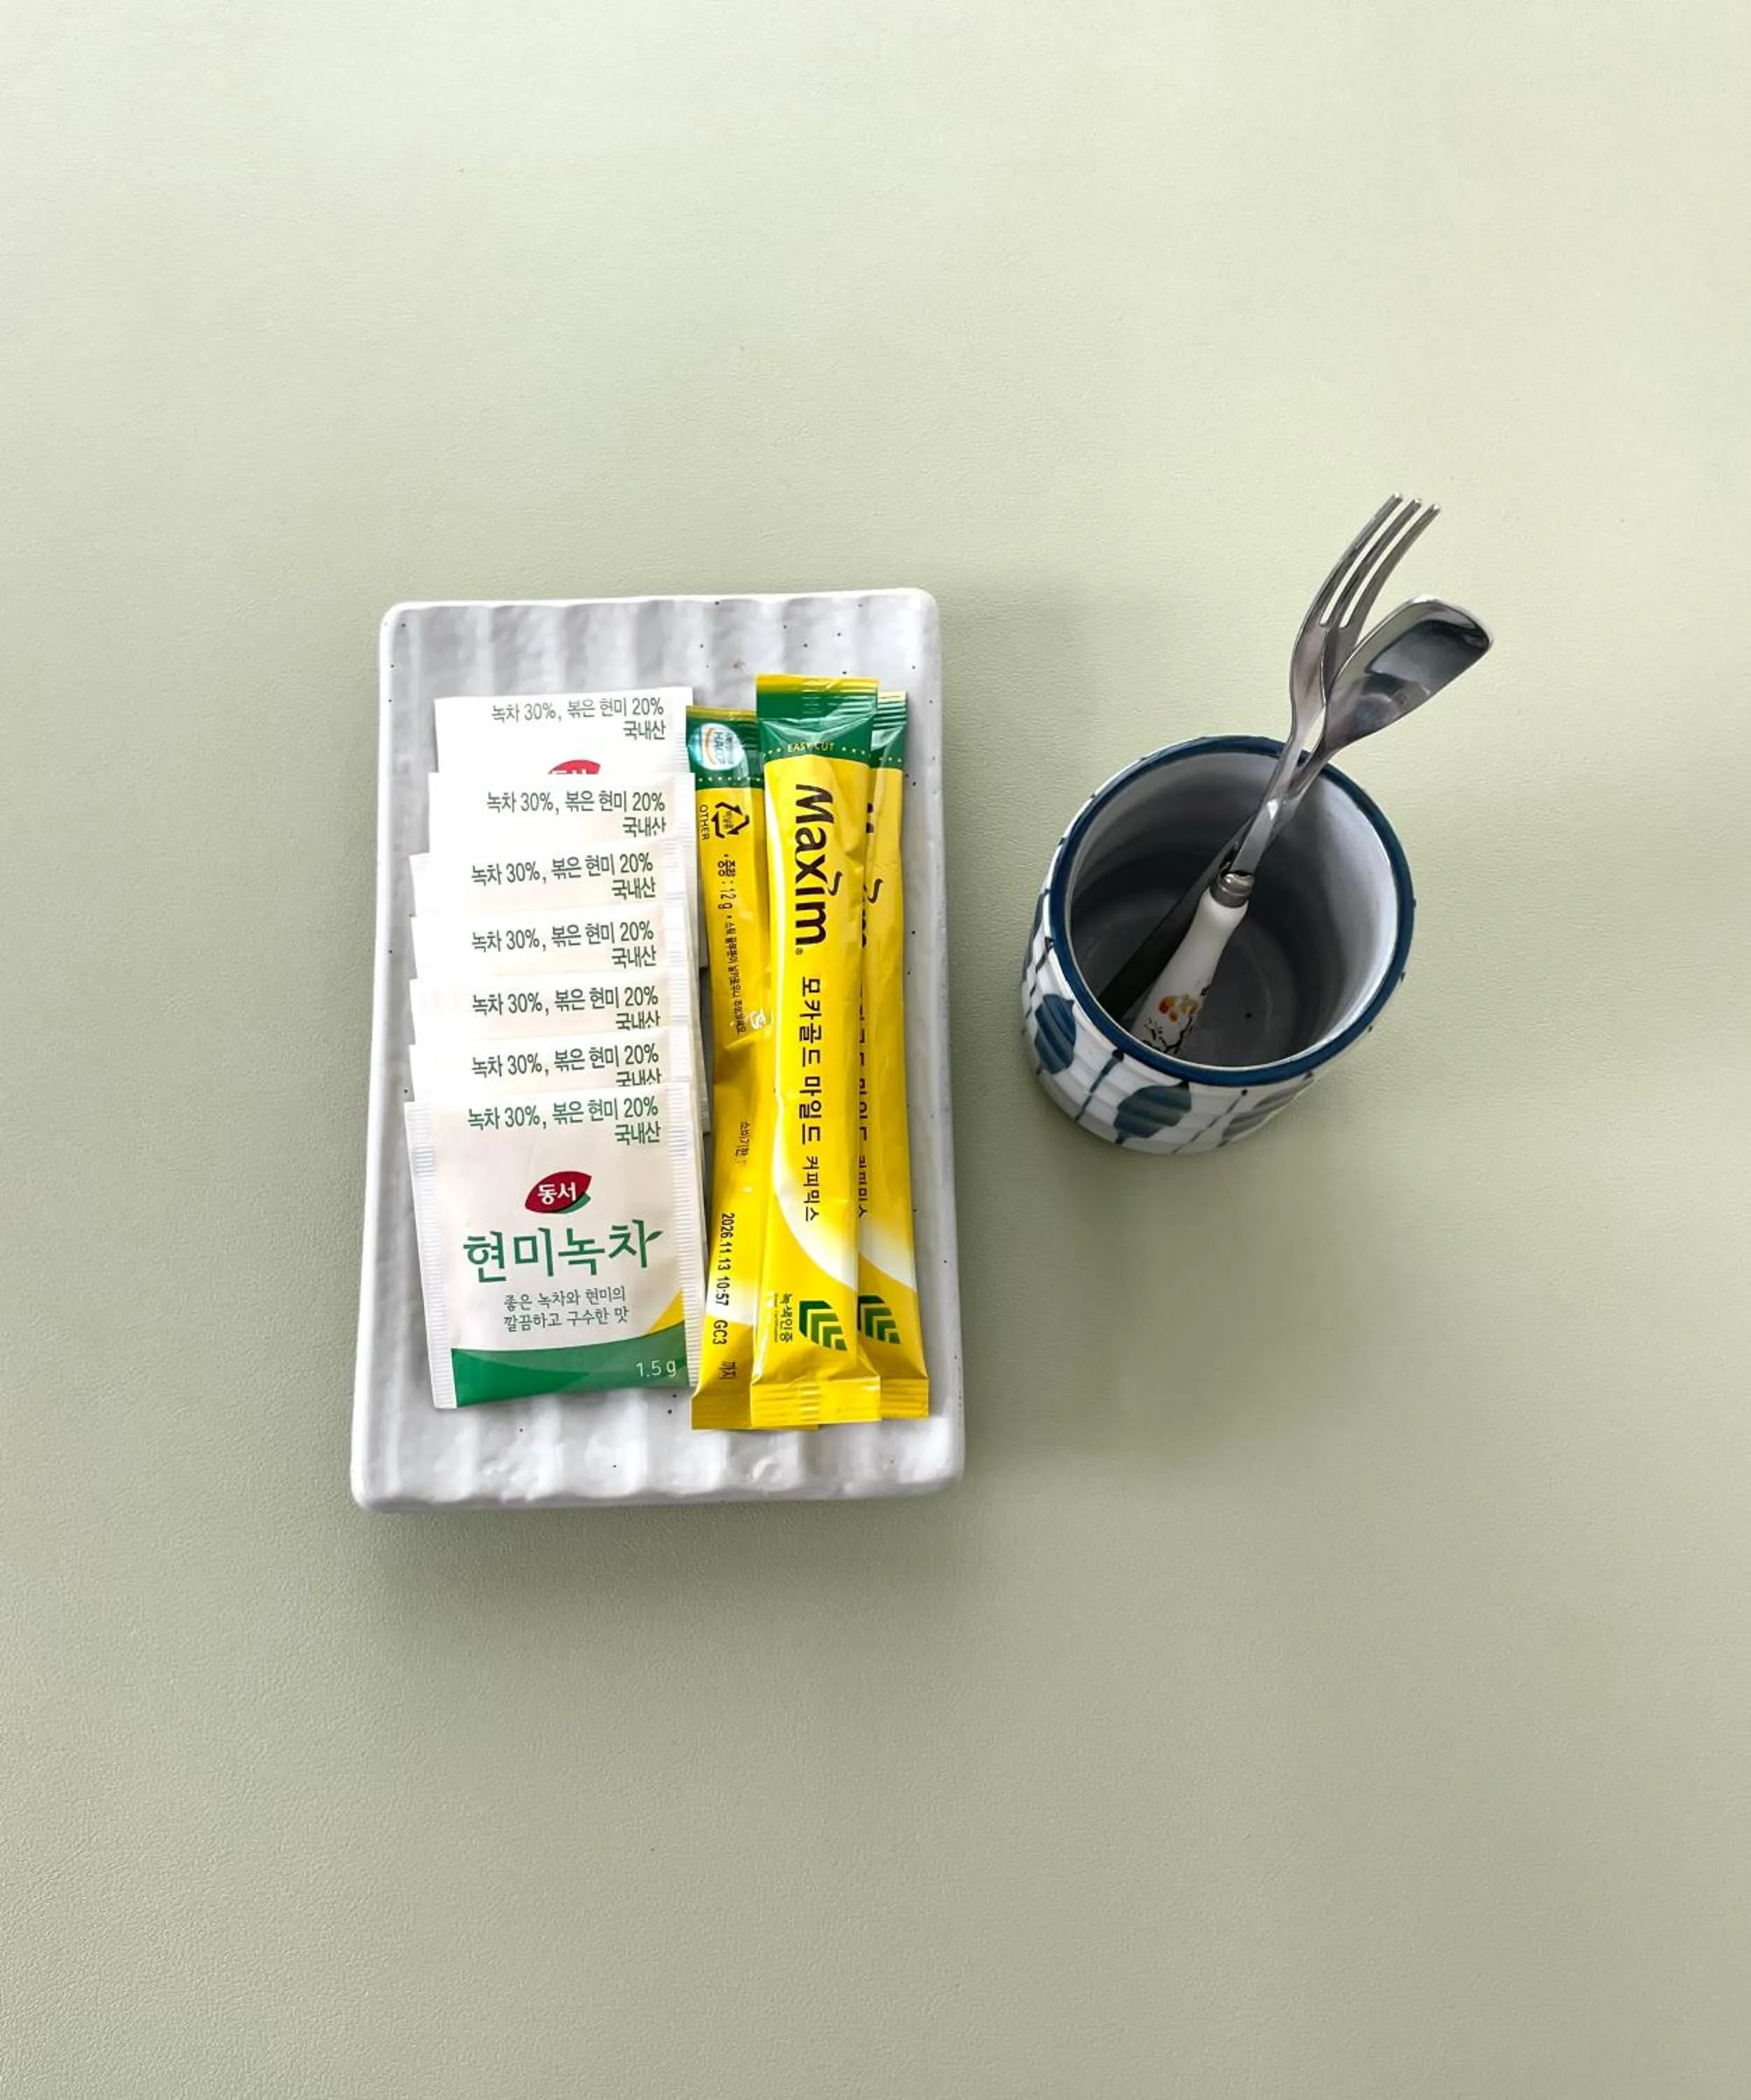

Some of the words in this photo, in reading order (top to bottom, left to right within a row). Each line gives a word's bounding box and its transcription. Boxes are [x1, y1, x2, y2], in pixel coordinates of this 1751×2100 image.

[492, 704, 520, 723] 녹차
[524, 702, 562, 722] 30%,
[567, 699, 596, 718] 볶은
[599, 696, 627, 718] 현미
[632, 697, 664, 716] 20%
[623, 720, 666, 741] 국내산
[486, 791, 517, 813] 녹차
[520, 792, 559, 816] 30%,
[565, 790, 595, 812] 볶은
[598, 790, 627, 813] 현미
[632, 792, 666, 812] 20%
[622, 816, 667, 838] 국내산
[700, 804, 710, 841] OTHER
[471, 863, 502, 887] 녹차
[506, 861, 547, 884] 30%,
[551, 856, 582, 880] 볶은
[584, 853, 615, 877] 현미
[619, 852, 653, 874] 20%
[795, 783, 843, 946] Maxim
[611, 876, 656, 900] 국내산
[472, 930, 502, 953] 녹차
[505, 928, 547, 952] 30%,
[551, 924, 582, 948] 볶은
[584, 922, 615, 945] 현미
[619, 920, 654, 941] 20%
[611, 944, 657, 969] 국내산
[472, 993, 505, 1016] 녹차
[507, 992, 549, 1016] 30%,
[554, 988, 586, 1012] 볶은
[589, 986, 619, 1009] 현미
[624, 985, 659, 1007] 20%
[615, 1009, 661, 1031] 국내산
[799, 976, 822, 1068] 모카골드
[472, 1054, 503, 1079] 녹차
[507, 1052, 549, 1076] 30%,
[554, 1048, 586, 1072] 볶은
[589, 1045, 619, 1069] 현미
[624, 1042, 659, 1065] 20%
[467, 1107, 500, 1131] 녹차
[504, 1105, 547, 1130] 30%,
[551, 1100, 584, 1125] 볶은
[587, 1097, 619, 1122] 현미
[624, 1095, 659, 1119] 20%
[799, 1076, 822, 1145] 마일드
[614, 1122, 661, 1146] 국내산
[537, 1182, 579, 1205] 동서
[803, 1156, 820, 1222] 커피믹스
[463, 1219, 663, 1282] 현미녹차
[717, 1212, 736, 1270] 2026.11.13
[503, 1294, 533, 1312] 좋은
[537, 1289, 581, 1309] 녹차와
[584, 1285, 626, 1306] 현미의
[715, 1276, 731, 1306] 10:57
[503, 1312, 563, 1333] 깔끔하고
[566, 1307, 610, 1326] 구수한
[614, 1306, 629, 1324] 맛
[712, 1320, 729, 1345] GC3
[779, 1293, 793, 1343] 녹색인증
